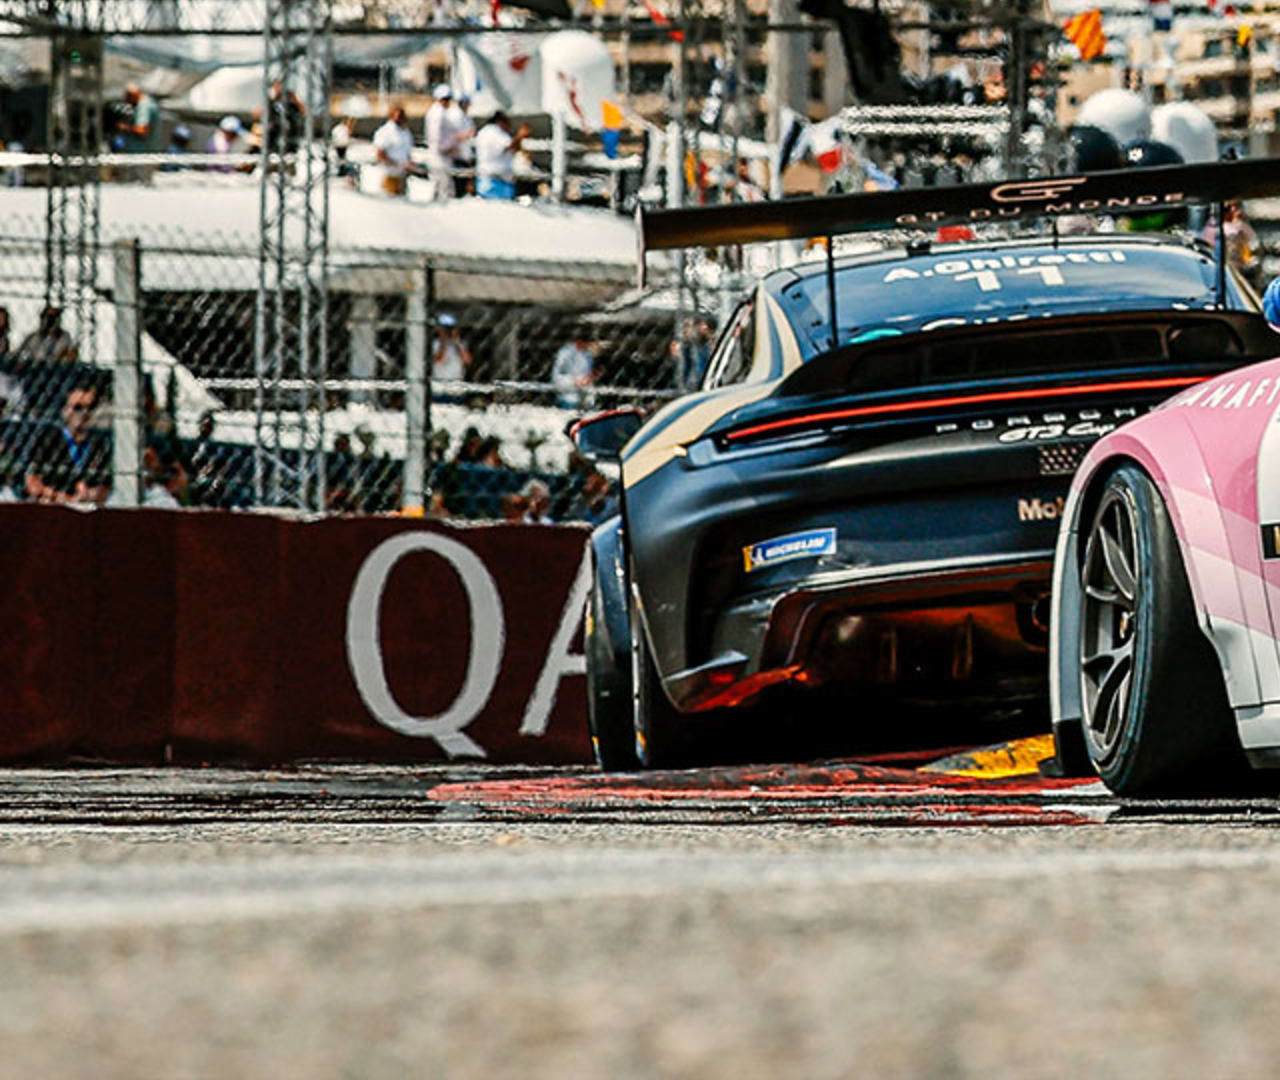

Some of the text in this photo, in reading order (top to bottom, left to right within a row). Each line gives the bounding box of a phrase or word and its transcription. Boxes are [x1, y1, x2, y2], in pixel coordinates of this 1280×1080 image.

[970, 207, 1020, 218] DU
[1046, 192, 1184, 212] MONDE
[954, 265, 1066, 292] 11
[999, 423, 1065, 443] GT3
